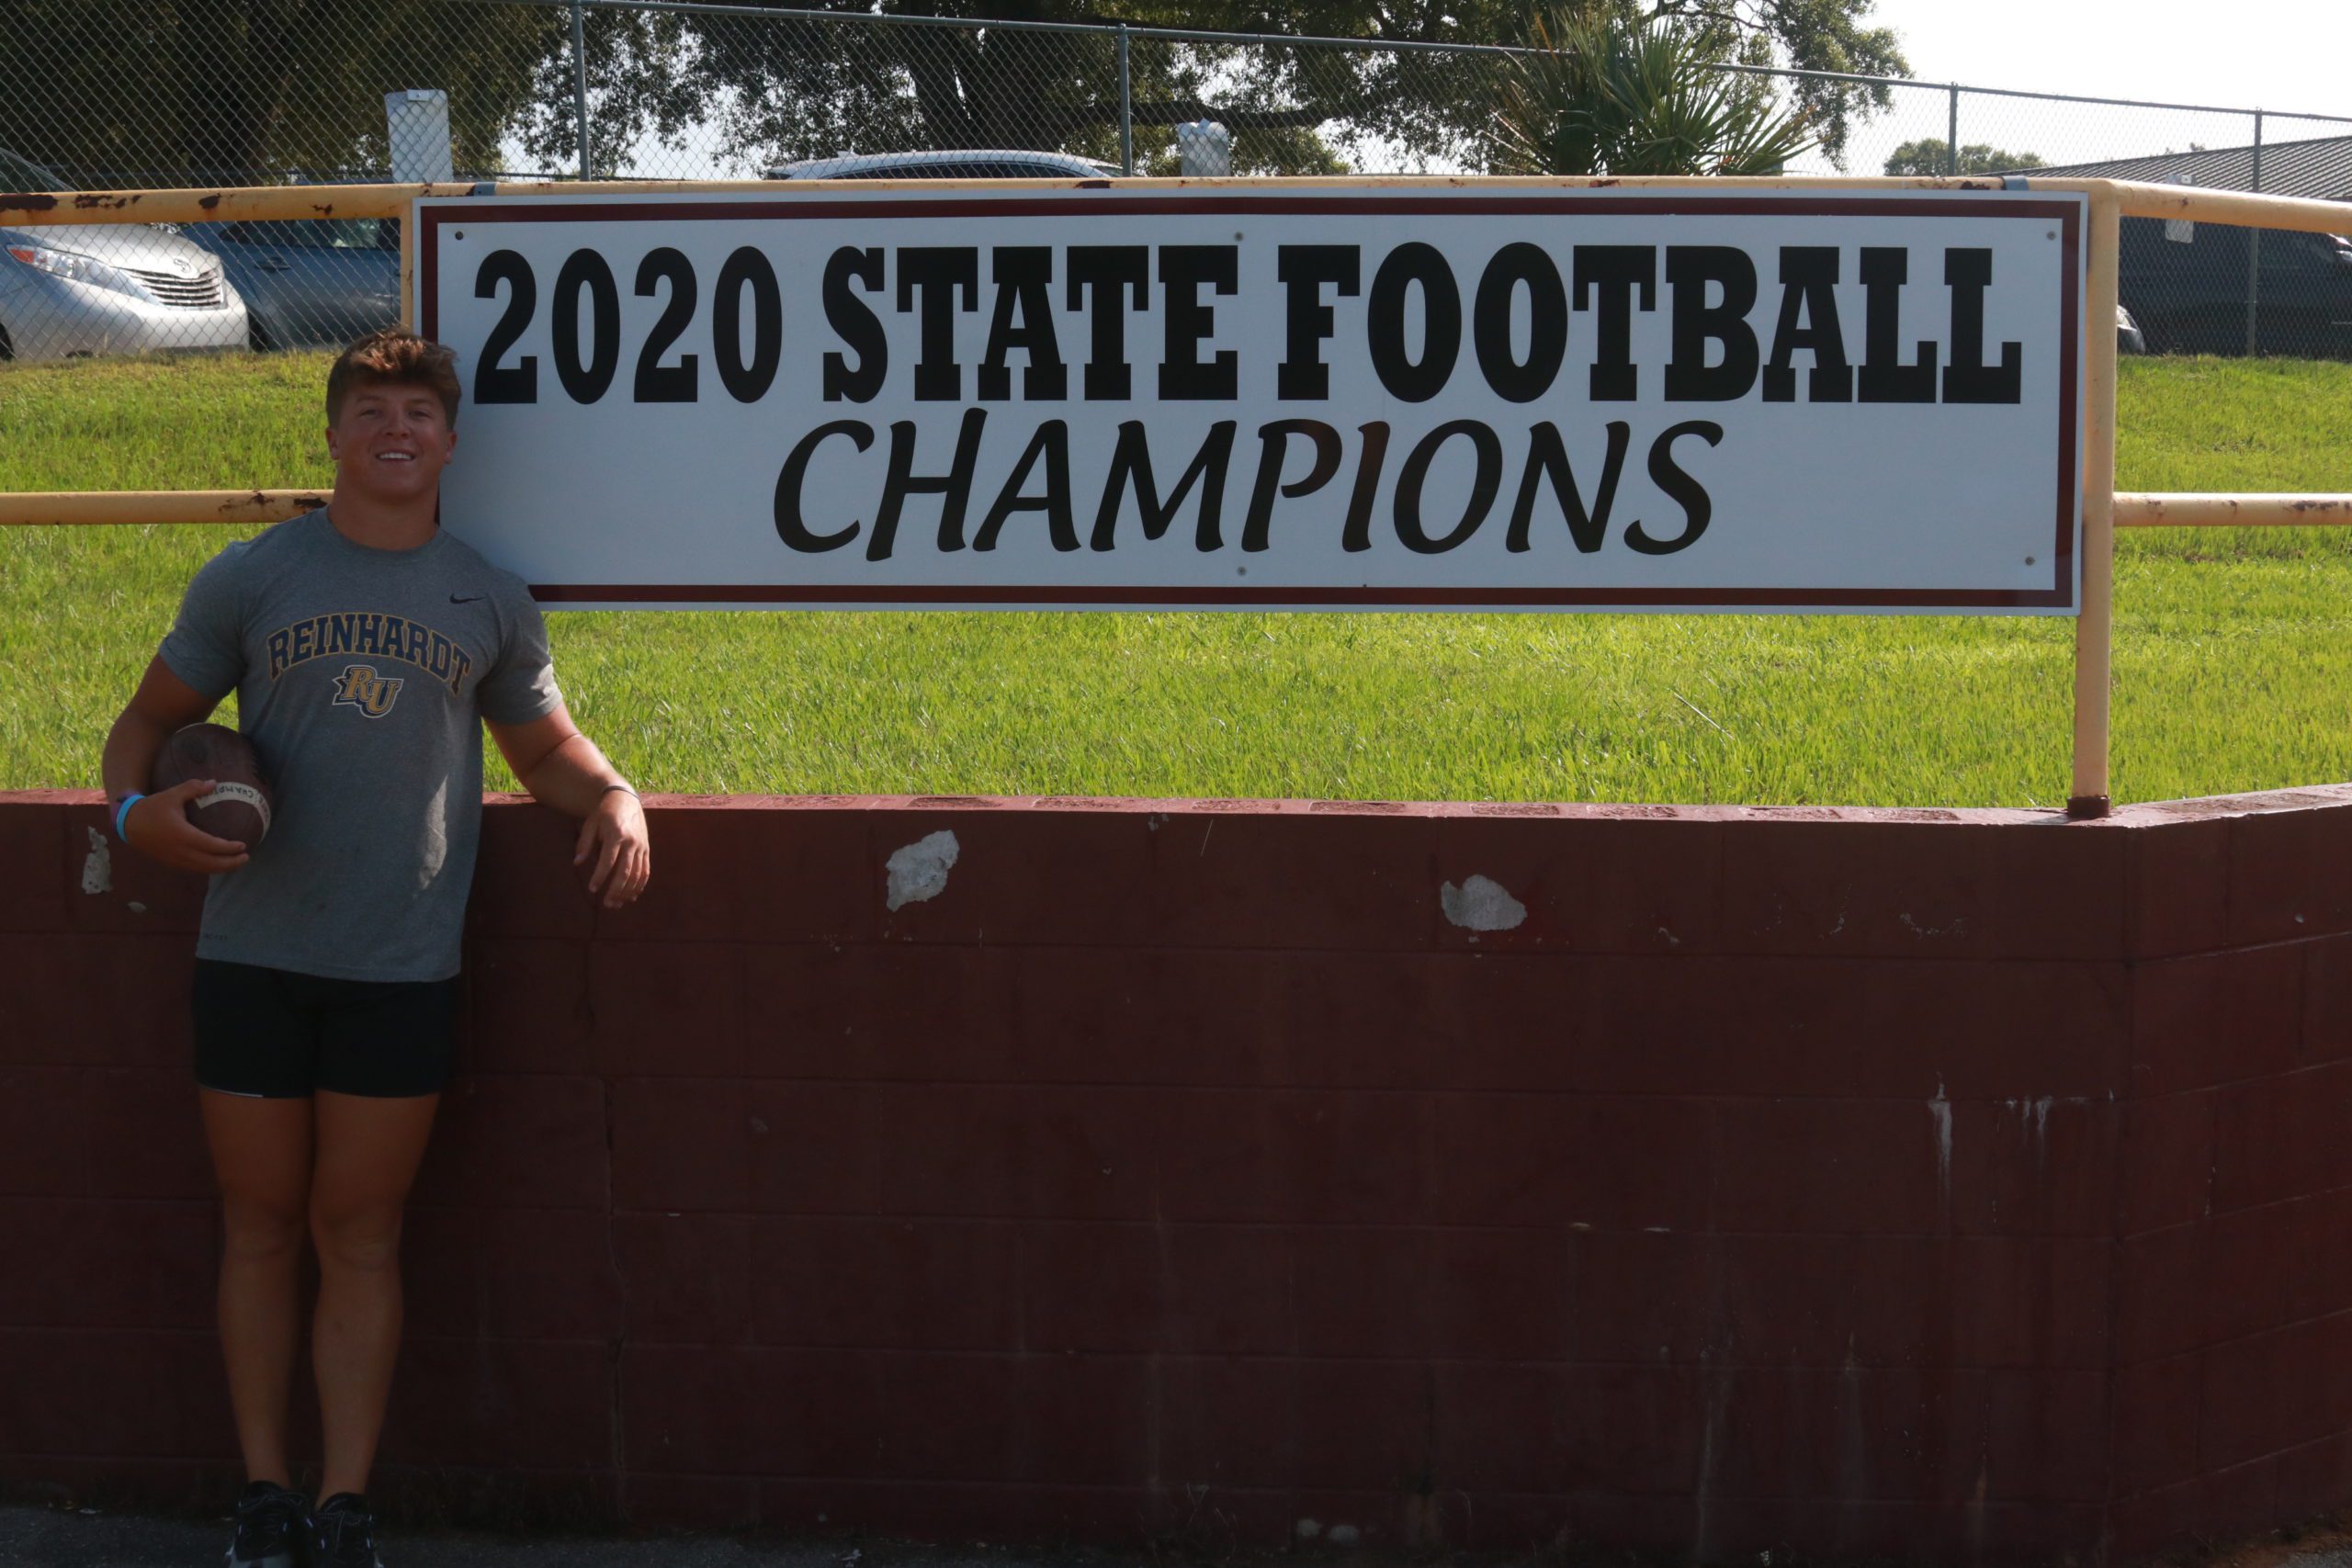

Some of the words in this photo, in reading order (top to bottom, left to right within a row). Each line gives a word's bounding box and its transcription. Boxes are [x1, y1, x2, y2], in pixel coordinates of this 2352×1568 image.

[474, 246, 783, 404] 2020
[822, 245, 1238, 404] STATE
[1277, 242, 2021, 404] FOOTBALL
[774, 408, 1724, 561] CHAMPIONS
[268, 612, 471, 695] REINHARDT
[333, 665, 403, 718] RU
[214, 785, 254, 799] CHAMP
